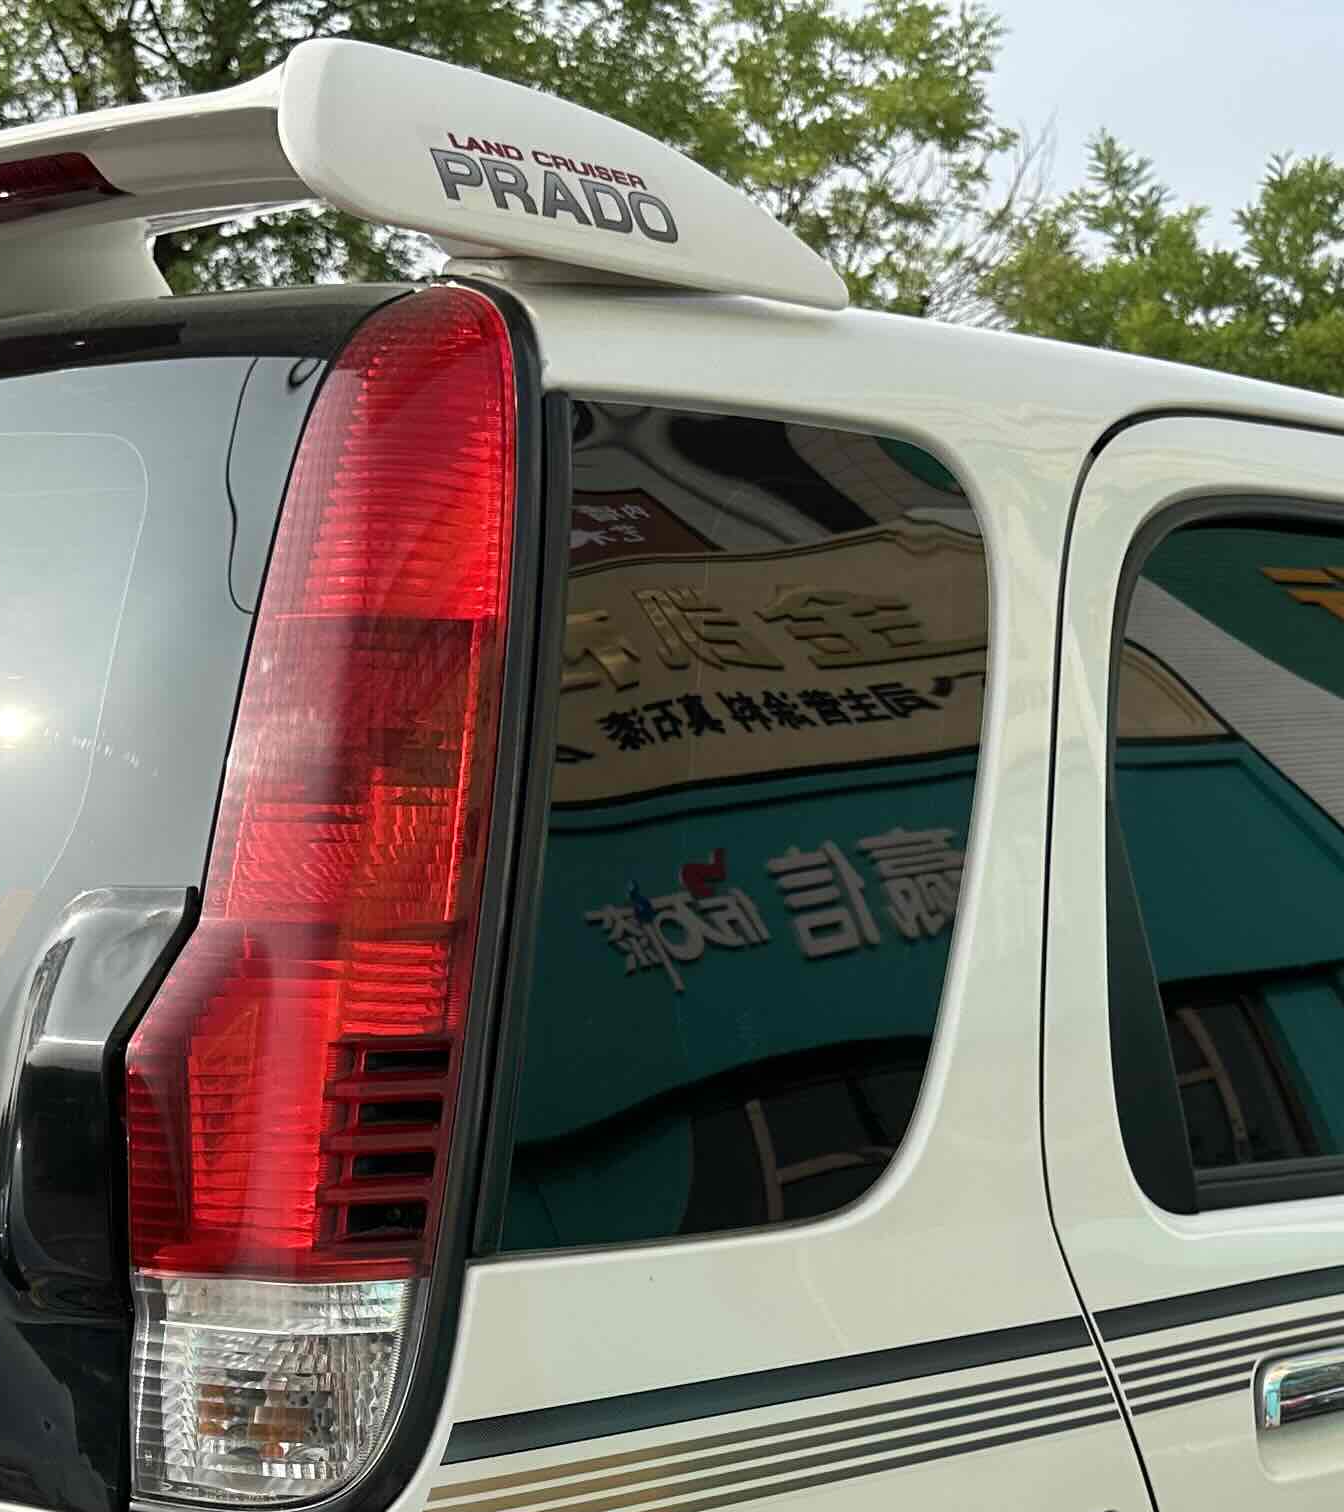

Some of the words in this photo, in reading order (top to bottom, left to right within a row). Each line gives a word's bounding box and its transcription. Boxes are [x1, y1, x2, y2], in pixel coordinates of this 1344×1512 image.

[429, 147, 679, 243] PRADO
[447, 132, 524, 161] LAND
[531, 150, 648, 190] CRUISER
